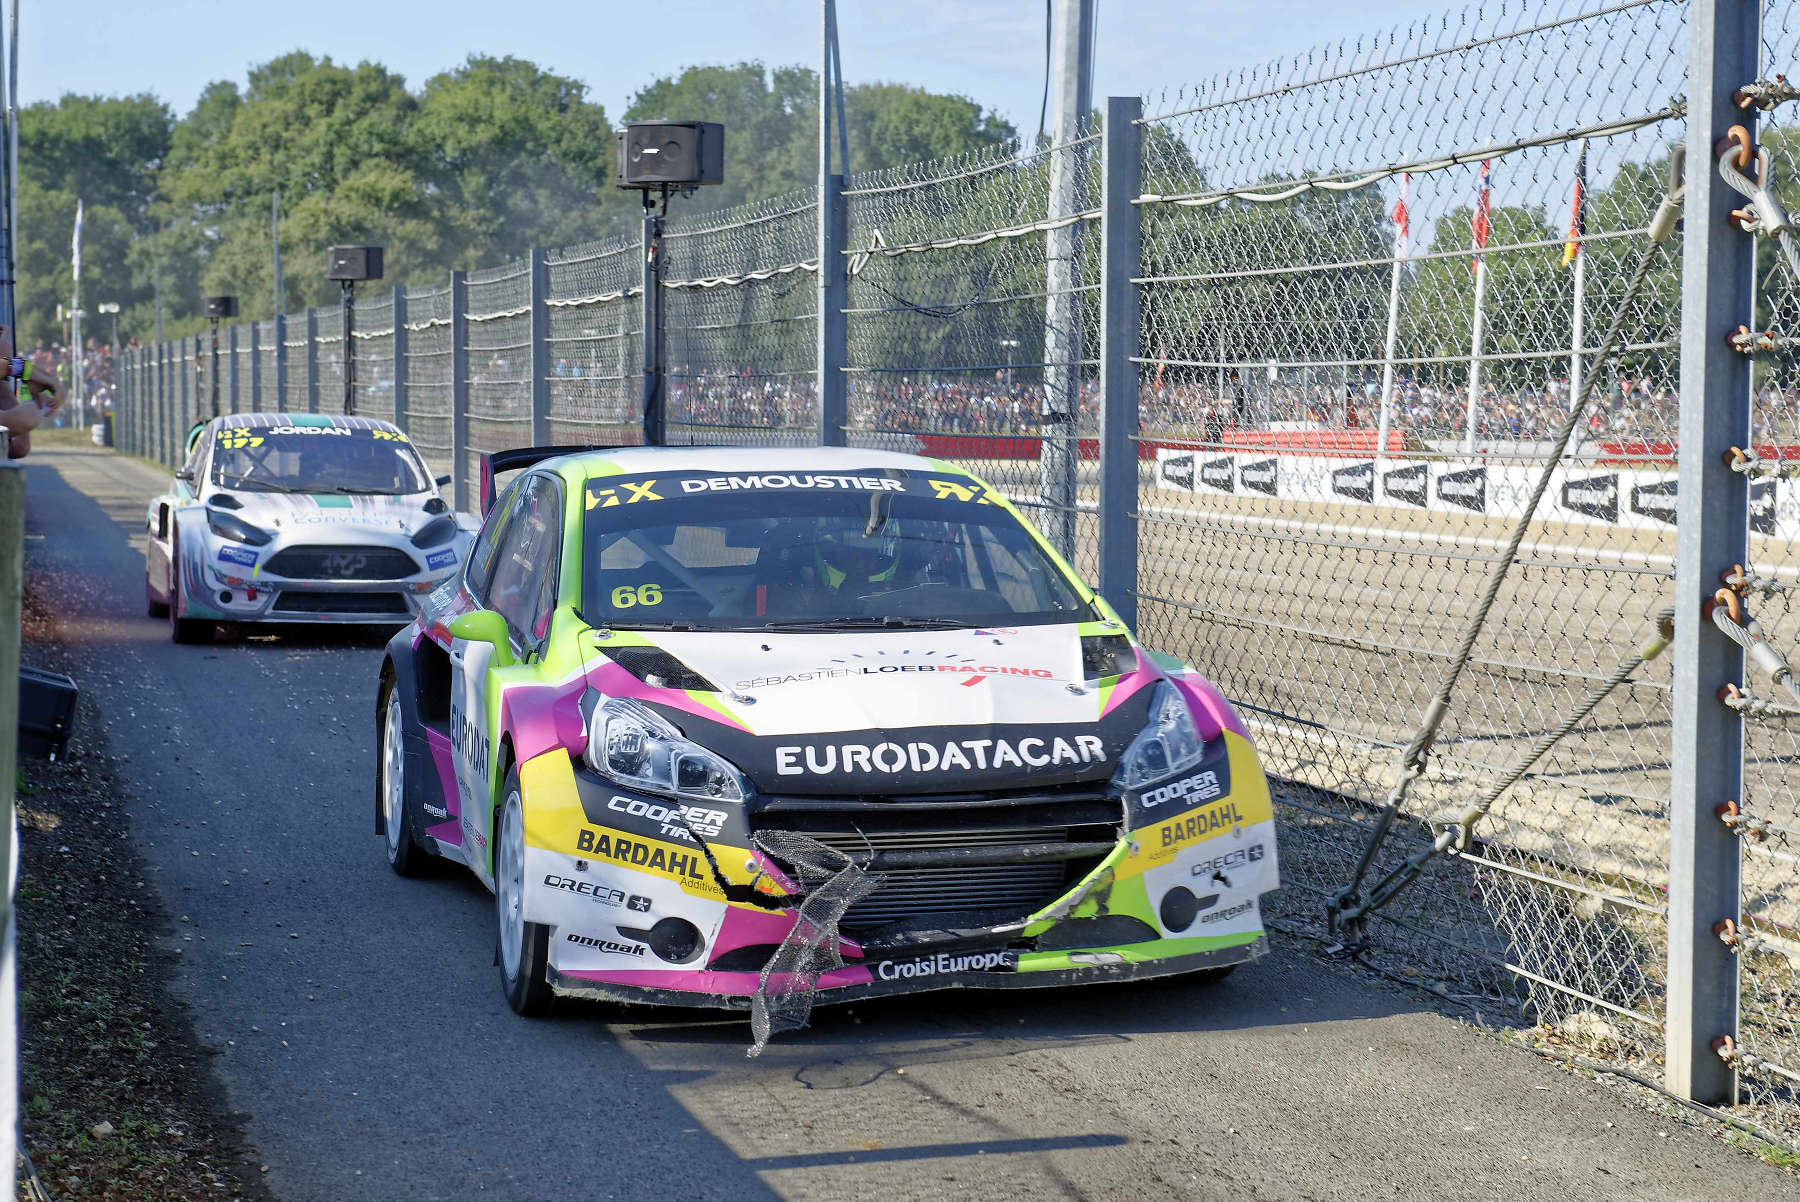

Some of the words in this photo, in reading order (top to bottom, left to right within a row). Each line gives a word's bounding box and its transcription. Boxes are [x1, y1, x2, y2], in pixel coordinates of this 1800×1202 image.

[222, 437, 264, 449] 177
[269, 426, 351, 436] JORDAN
[681, 475, 907, 494] DEMOUSTIER
[611, 583, 663, 609] 66
[775, 735, 1107, 776] EURODATACAR
[1141, 770, 1220, 808] COOPER
[1183, 784, 1221, 805] TIRES
[608, 796, 728, 827] COOPER
[660, 821, 722, 842] TIRES
[1162, 803, 1244, 848] BARDAHL
[576, 829, 705, 881] BARDAHL
[1190, 849, 1246, 876] ORECA
[544, 874, 626, 903] ORECA
[680, 877, 725, 896] Additives
